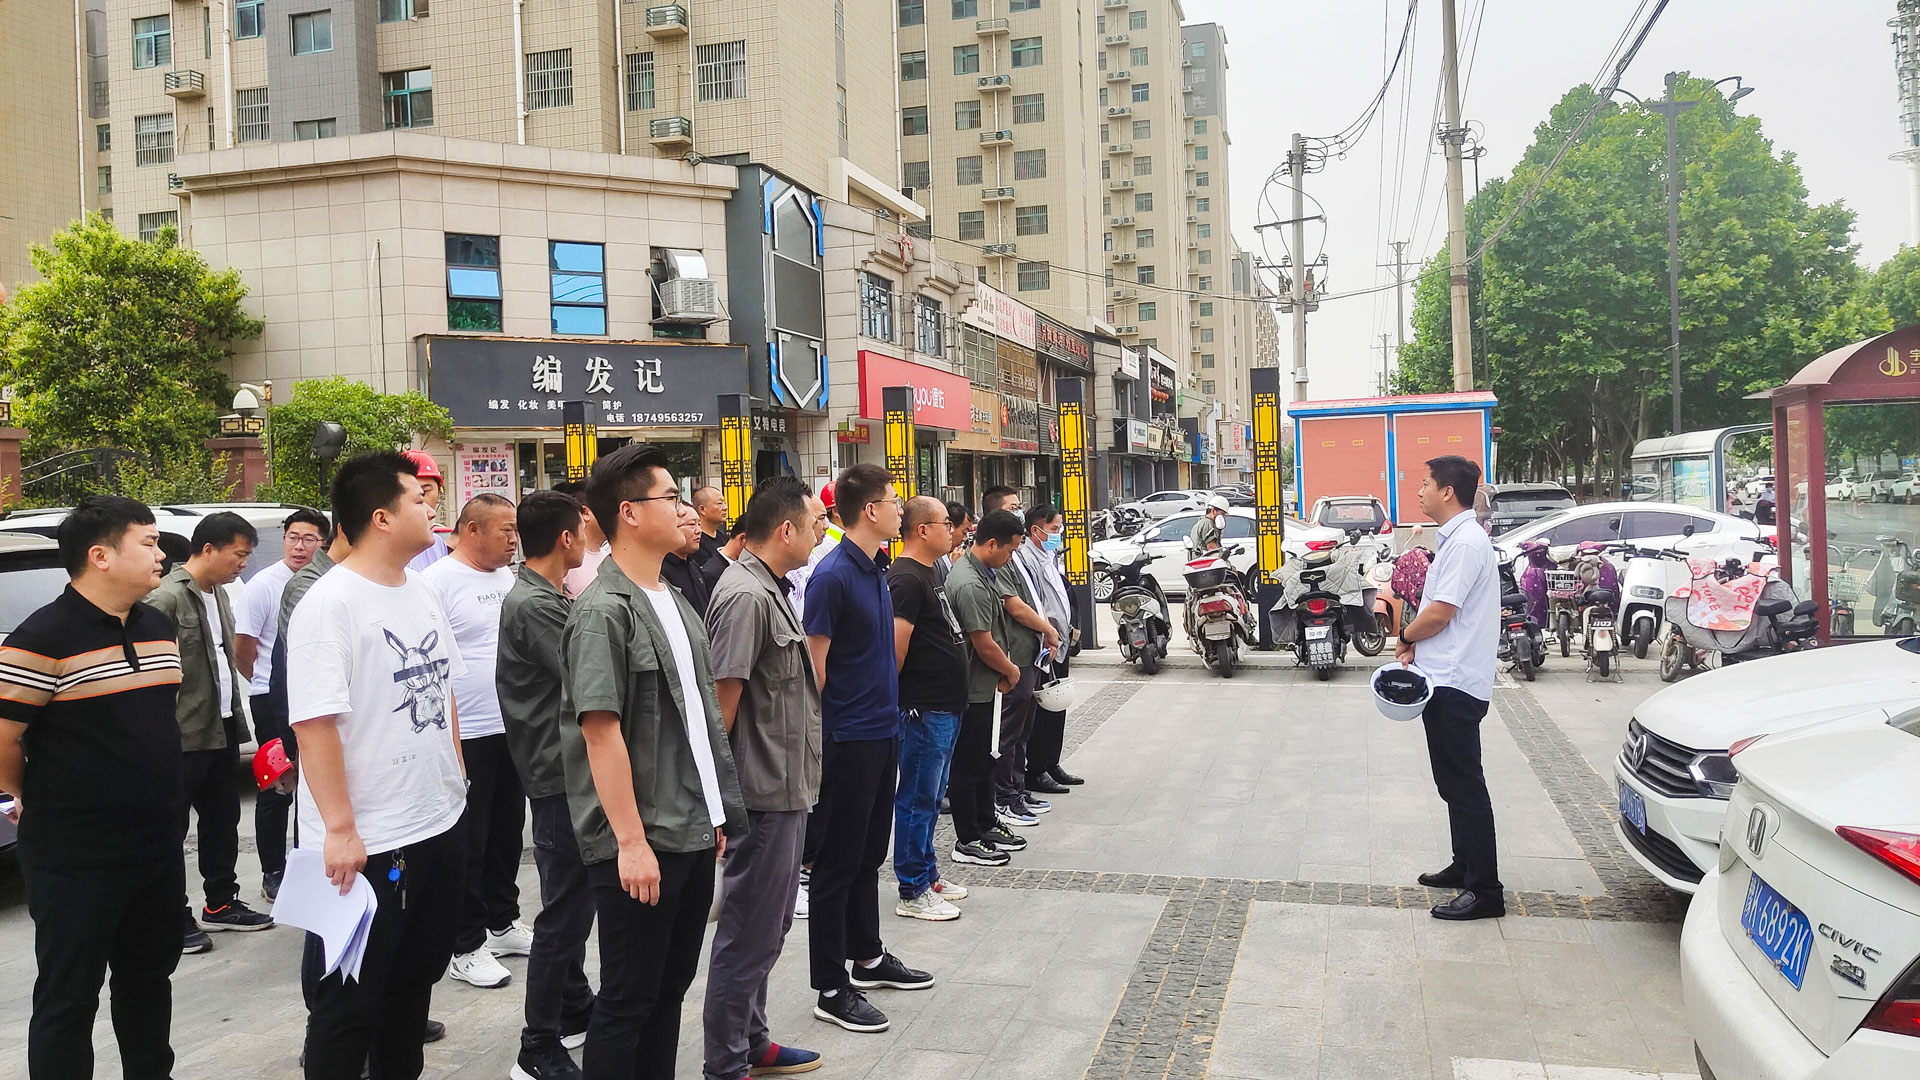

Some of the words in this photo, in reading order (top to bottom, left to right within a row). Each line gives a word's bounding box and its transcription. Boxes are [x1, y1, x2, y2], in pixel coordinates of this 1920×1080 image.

[532, 355, 665, 394] 编发记
[488, 400, 510, 410] 编发
[517, 400, 539, 410] 化妆
[606, 413, 625, 423] 电话
[631, 413, 704, 423] 18749563257
[753, 415, 786, 433] 艾特电竞
[1817, 922, 1883, 964] CIVIC
[1832, 954, 1867, 982] 220
